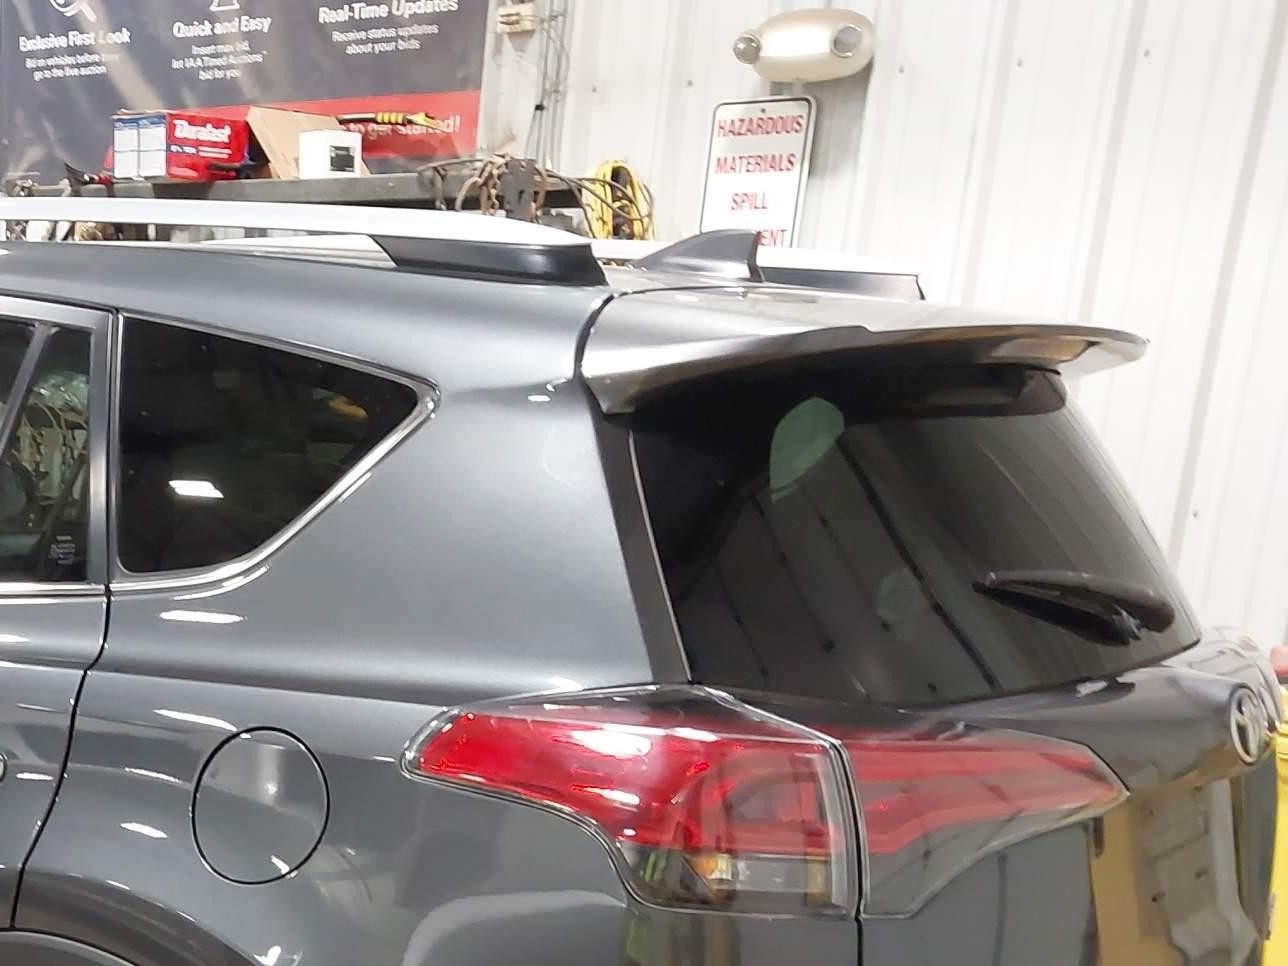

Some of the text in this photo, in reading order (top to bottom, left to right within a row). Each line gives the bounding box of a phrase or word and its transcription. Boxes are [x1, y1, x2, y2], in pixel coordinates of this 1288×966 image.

[318, 2, 390, 23] Real-Time
[172, 15, 273, 38] Quick and Easy
[367, 27, 397, 39] status
[397, 24, 440, 37] updates
[18, 27, 132, 52] Exclusive First Look
[345, 42, 373, 55] about
[373, 41, 396, 54] your
[717, 114, 804, 138] HAZARDOUS
[715, 152, 797, 175] MATERIALS
[731, 191, 768, 211] SPILL
